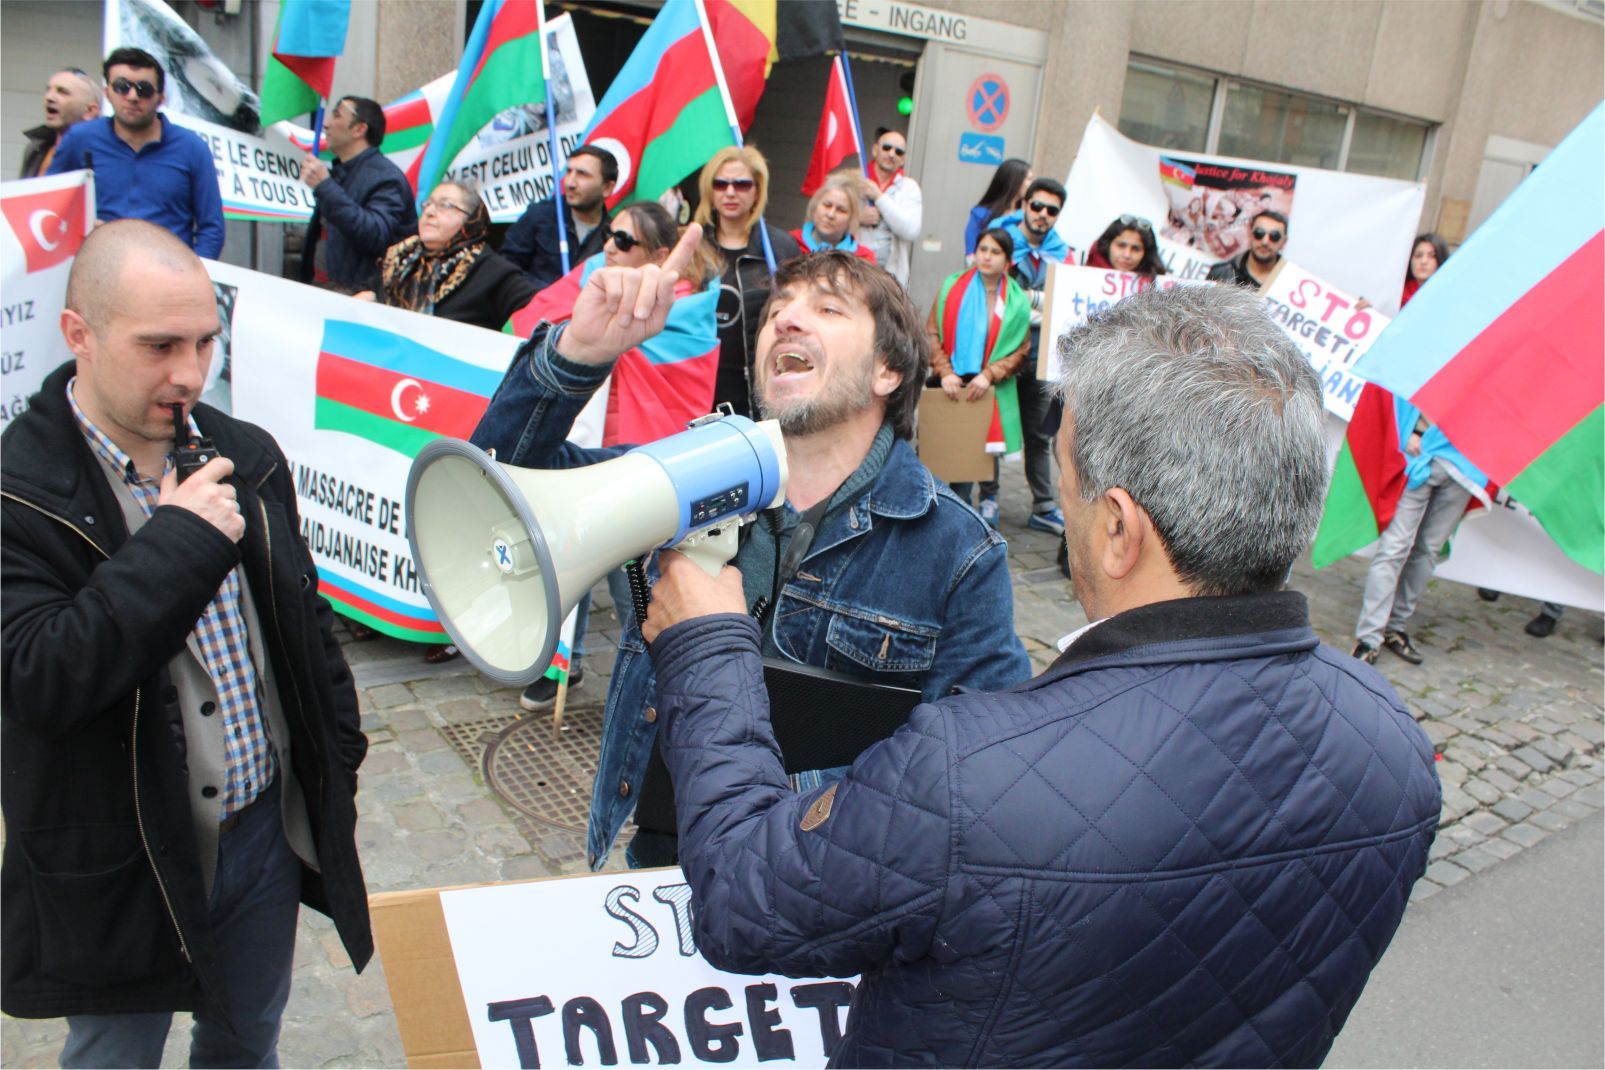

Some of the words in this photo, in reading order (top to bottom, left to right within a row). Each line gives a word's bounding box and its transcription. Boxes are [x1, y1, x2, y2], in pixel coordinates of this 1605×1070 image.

[889, 5, 967, 40] INGANG
[227, 140, 250, 167] LE
[254, 147, 303, 181] GENO
[492, 146, 535, 179] CELUI
[248, 175, 300, 207] TOUS
[484, 186, 509, 212] LE
[509, 173, 556, 208] MOND
[1289, 279, 1372, 340] STO
[297, 464, 375, 526] MASSACRE
[378, 496, 400, 536] DE
[301, 517, 389, 582] AIDJANAISE
[604, 884, 700, 959] ST
[487, 981, 858, 1070] TARGET
